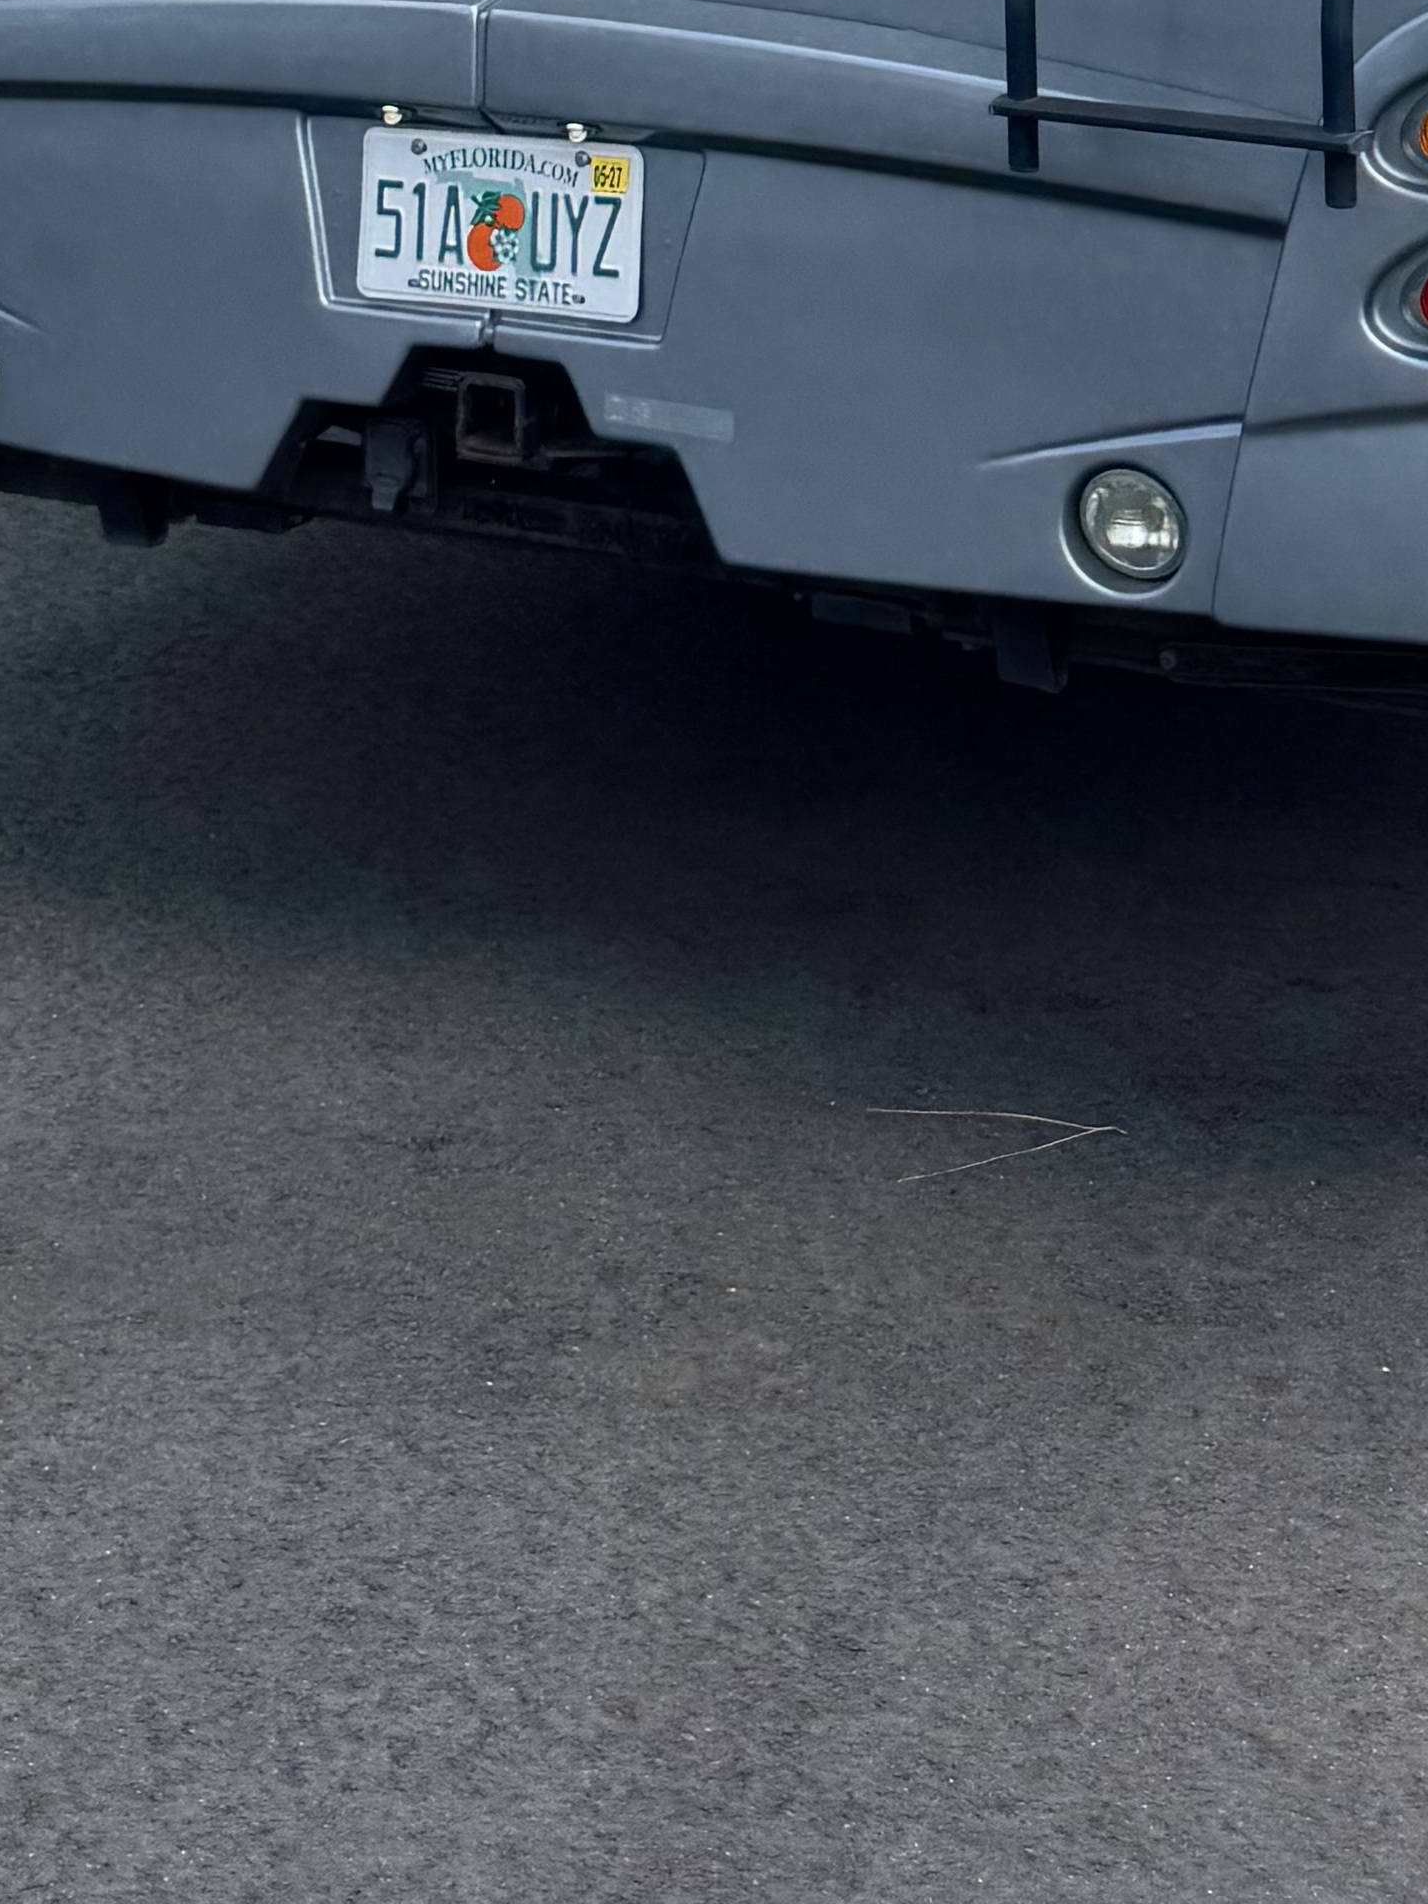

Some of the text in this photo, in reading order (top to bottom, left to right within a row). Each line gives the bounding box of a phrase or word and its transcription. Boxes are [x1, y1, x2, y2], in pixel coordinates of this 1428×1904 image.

[423, 147, 579, 188] MYFLORIDA.COM
[593, 164, 623, 189] 05-27
[374, 179, 622, 278] 51A UYZ
[419, 268, 572, 305] SUNSHINE STATE
